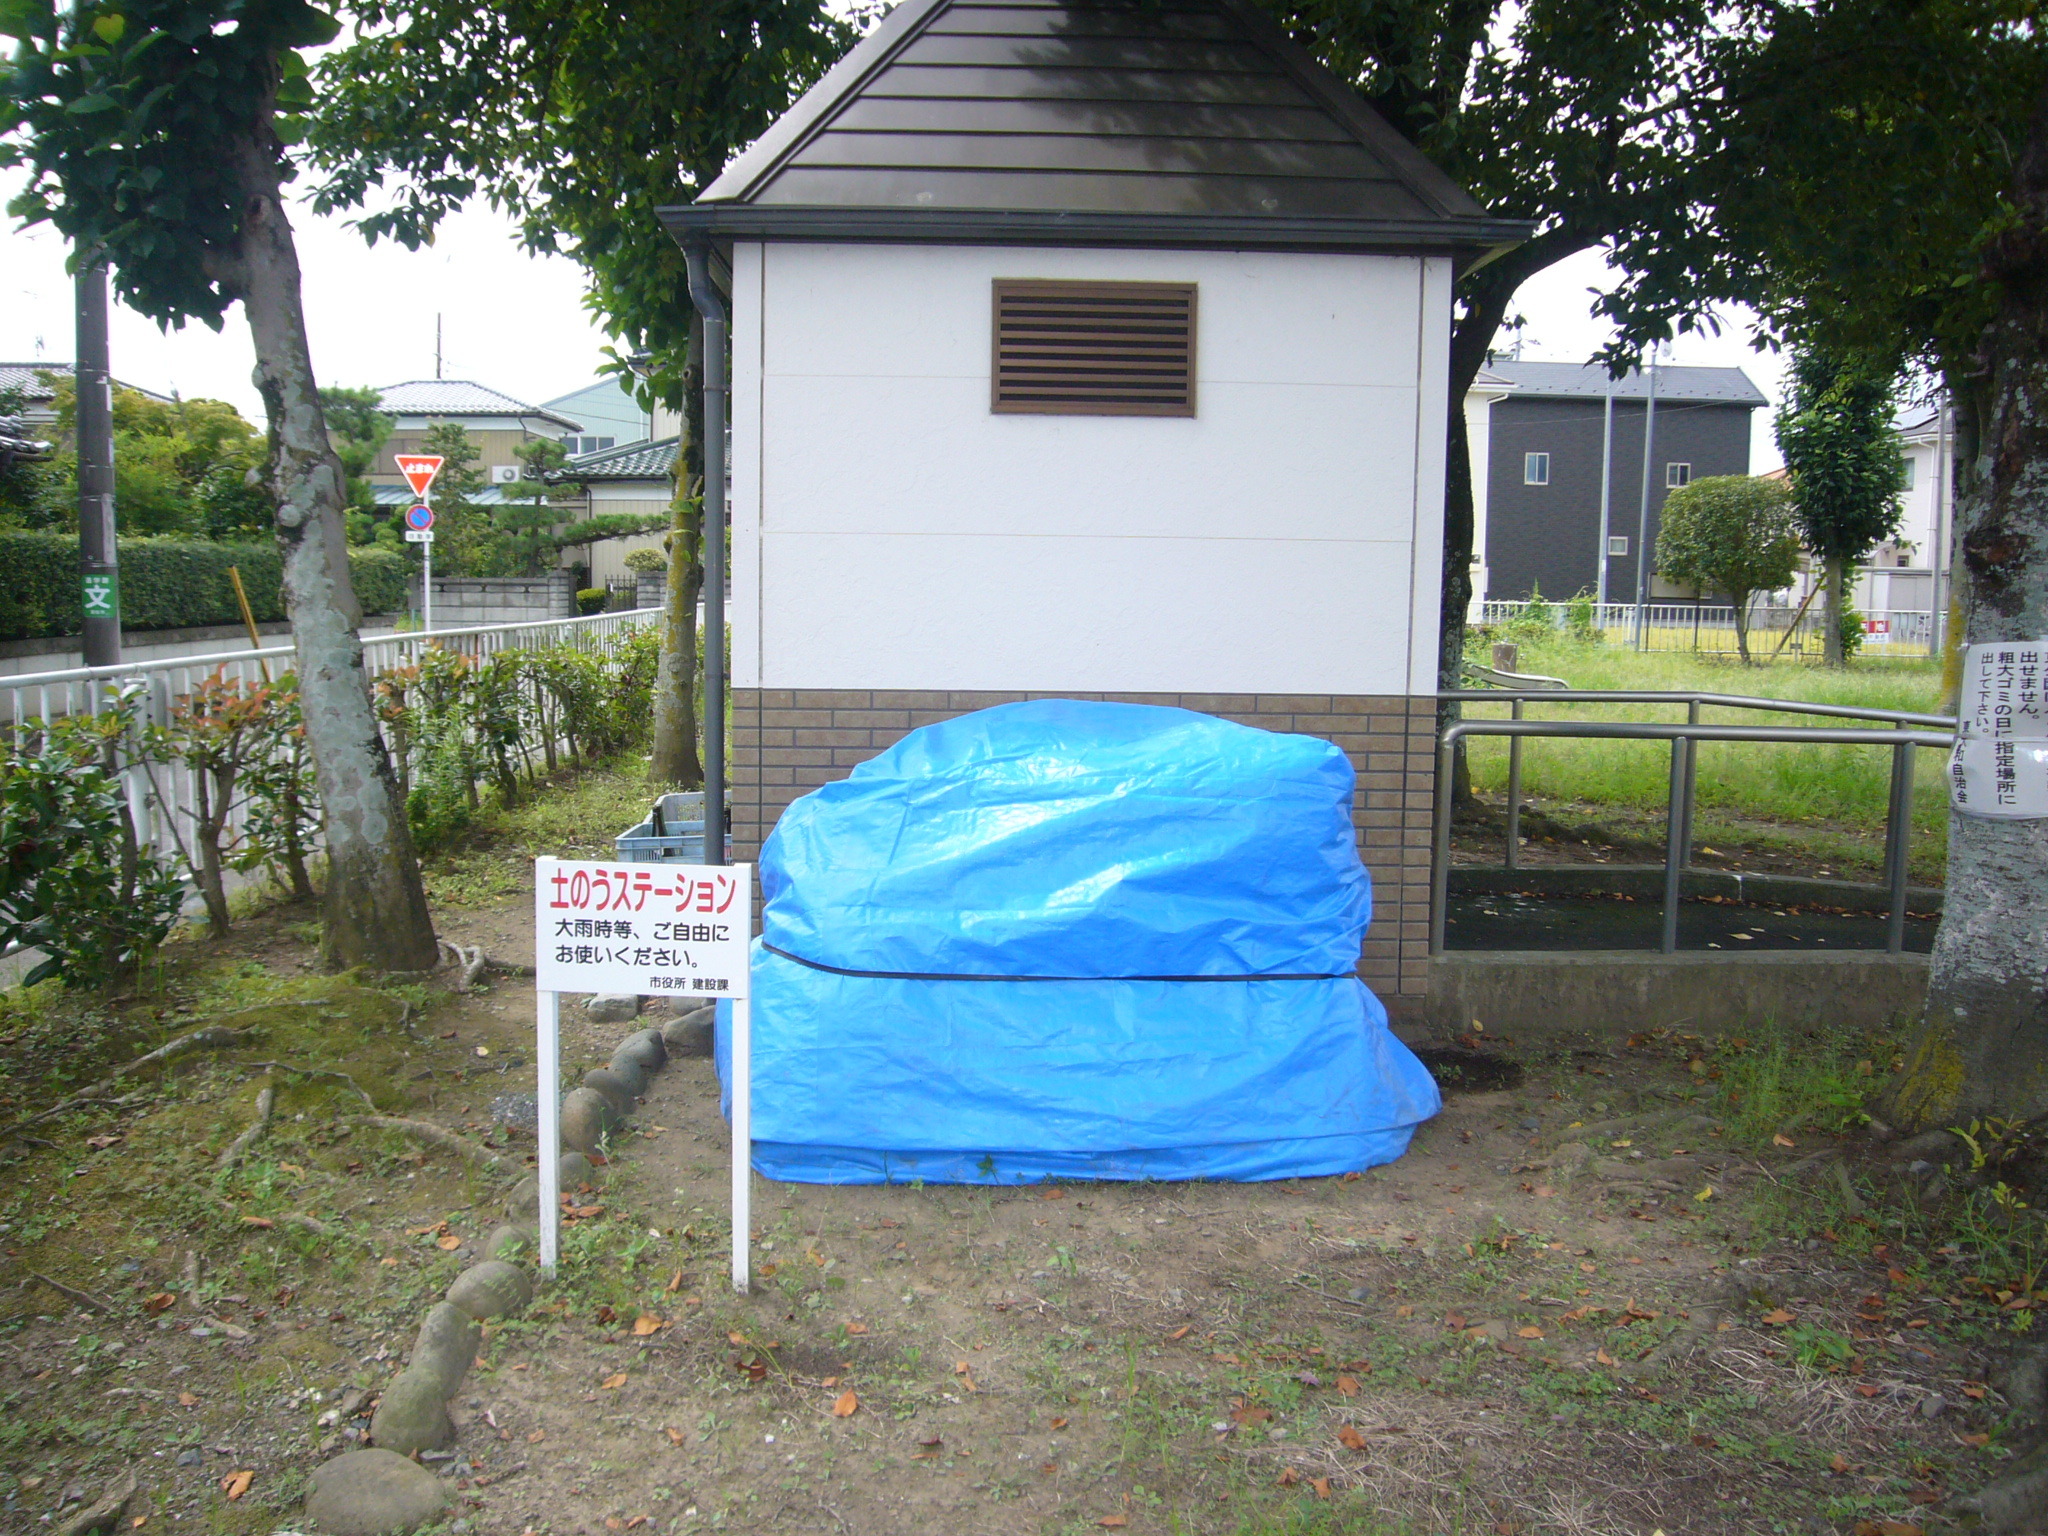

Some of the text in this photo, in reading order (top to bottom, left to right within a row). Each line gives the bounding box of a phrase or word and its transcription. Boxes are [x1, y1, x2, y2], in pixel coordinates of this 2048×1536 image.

[84, 584, 111, 609] 文
[1976, 652, 1994, 733] 出して下さい。
[2018, 651, 2040, 719] 出せません。
[550, 867, 736, 914] 土のうステーション
[554, 918, 730, 942] 大雨時等、ご自由に
[555, 944, 699, 969] お使いください。
[649, 976, 729, 991] 市役所 建設課
